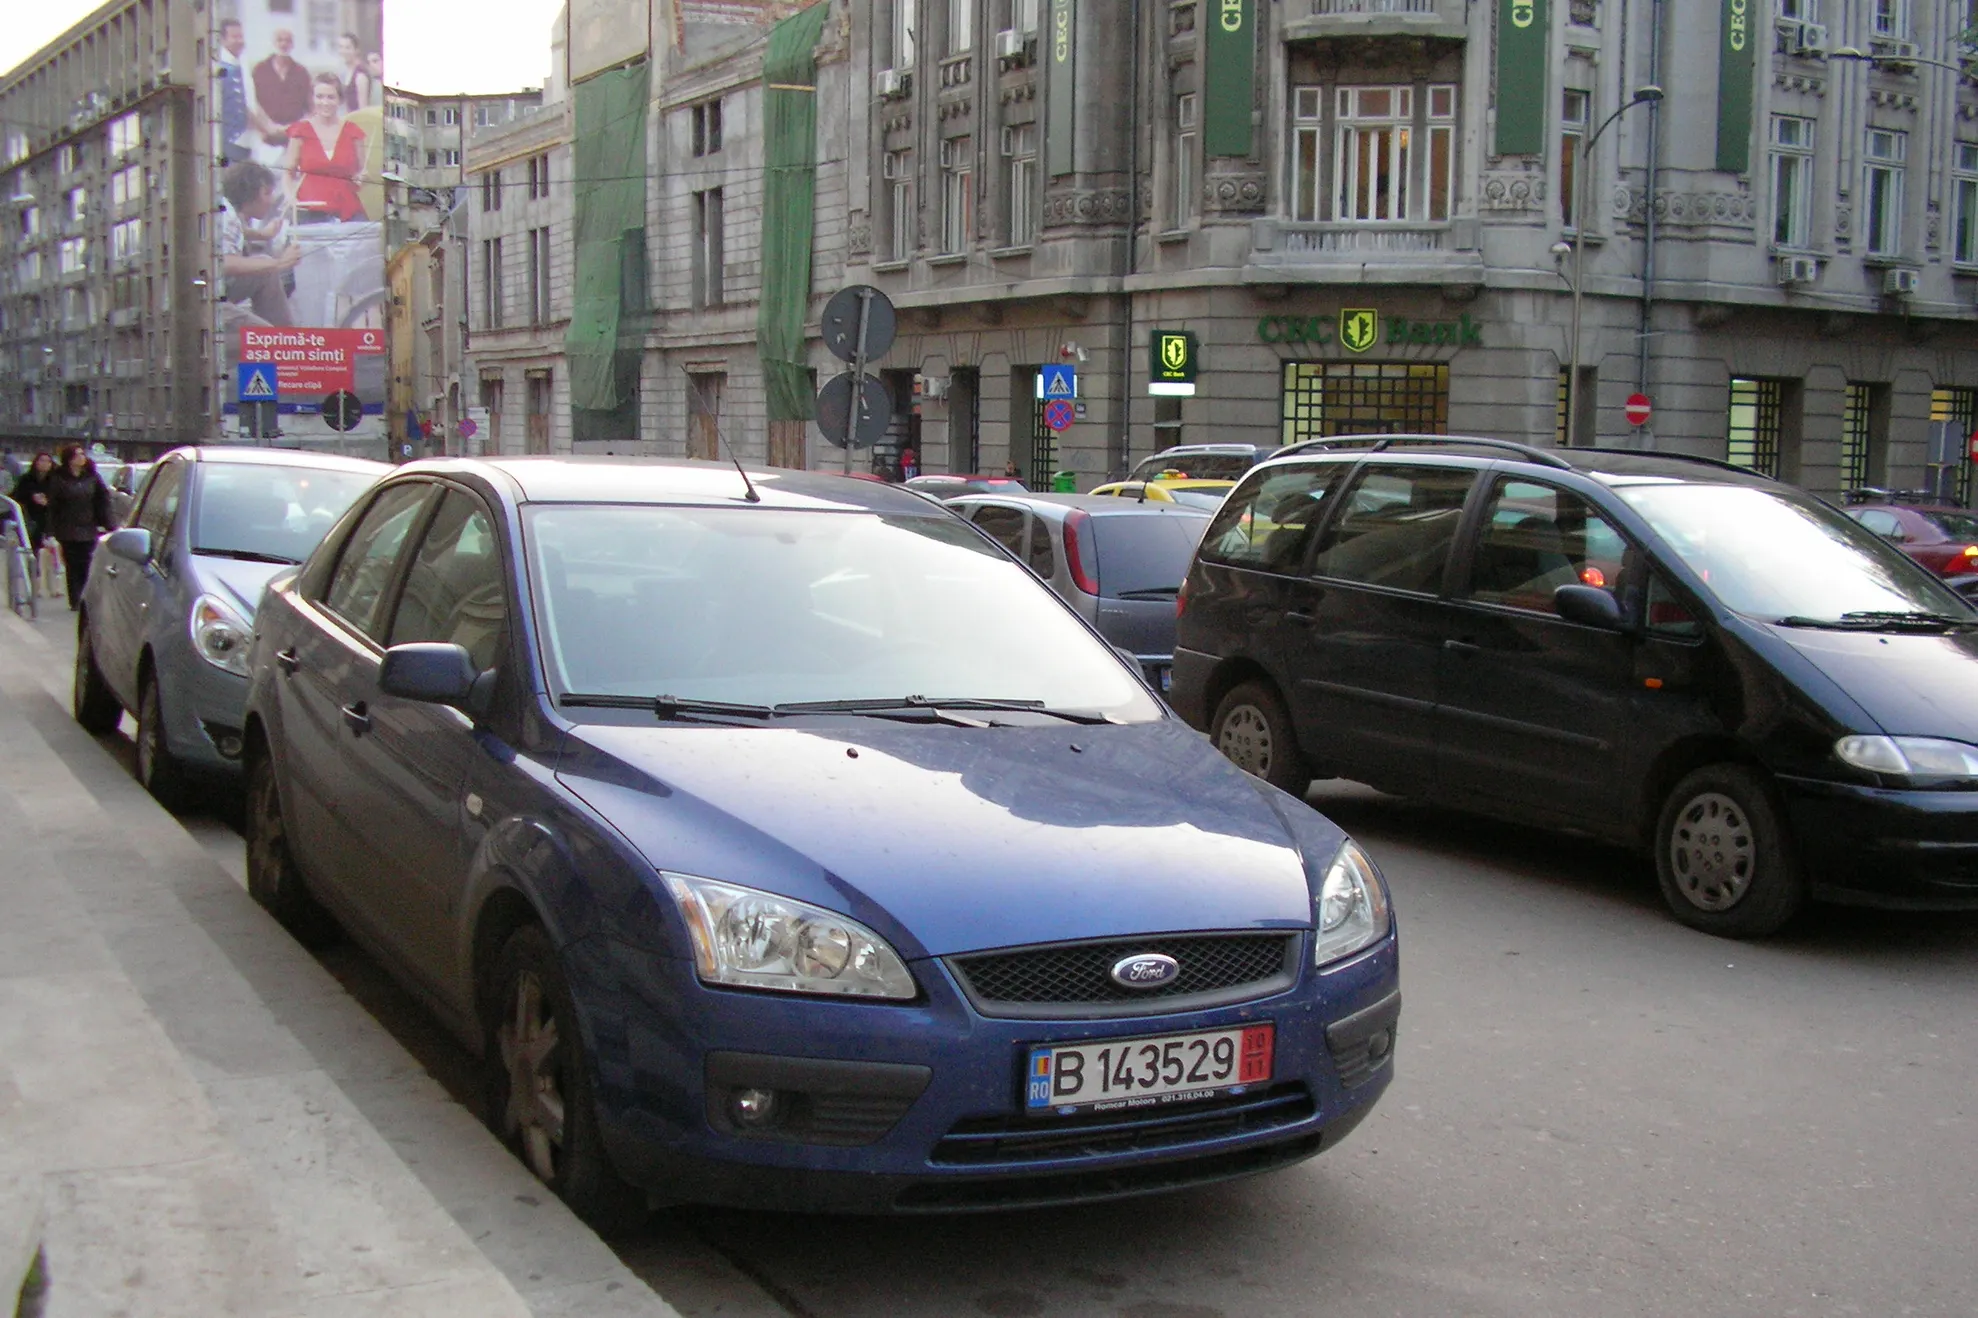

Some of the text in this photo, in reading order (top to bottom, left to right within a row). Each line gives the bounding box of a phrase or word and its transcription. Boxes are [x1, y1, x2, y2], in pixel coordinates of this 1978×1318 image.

[1056, 10, 1067, 62] CEC
[1258, 312, 1484, 345] CEC Bank
[246, 331, 326, 348] Exprimă-te
[274, 349, 306, 361] cum
[1130, 961, 1166, 980] Ford
[1053, 1037, 1235, 1097] B 143529
[1030, 1081, 1049, 1101] RO
[1127, 1097, 1156, 1108] Motors
